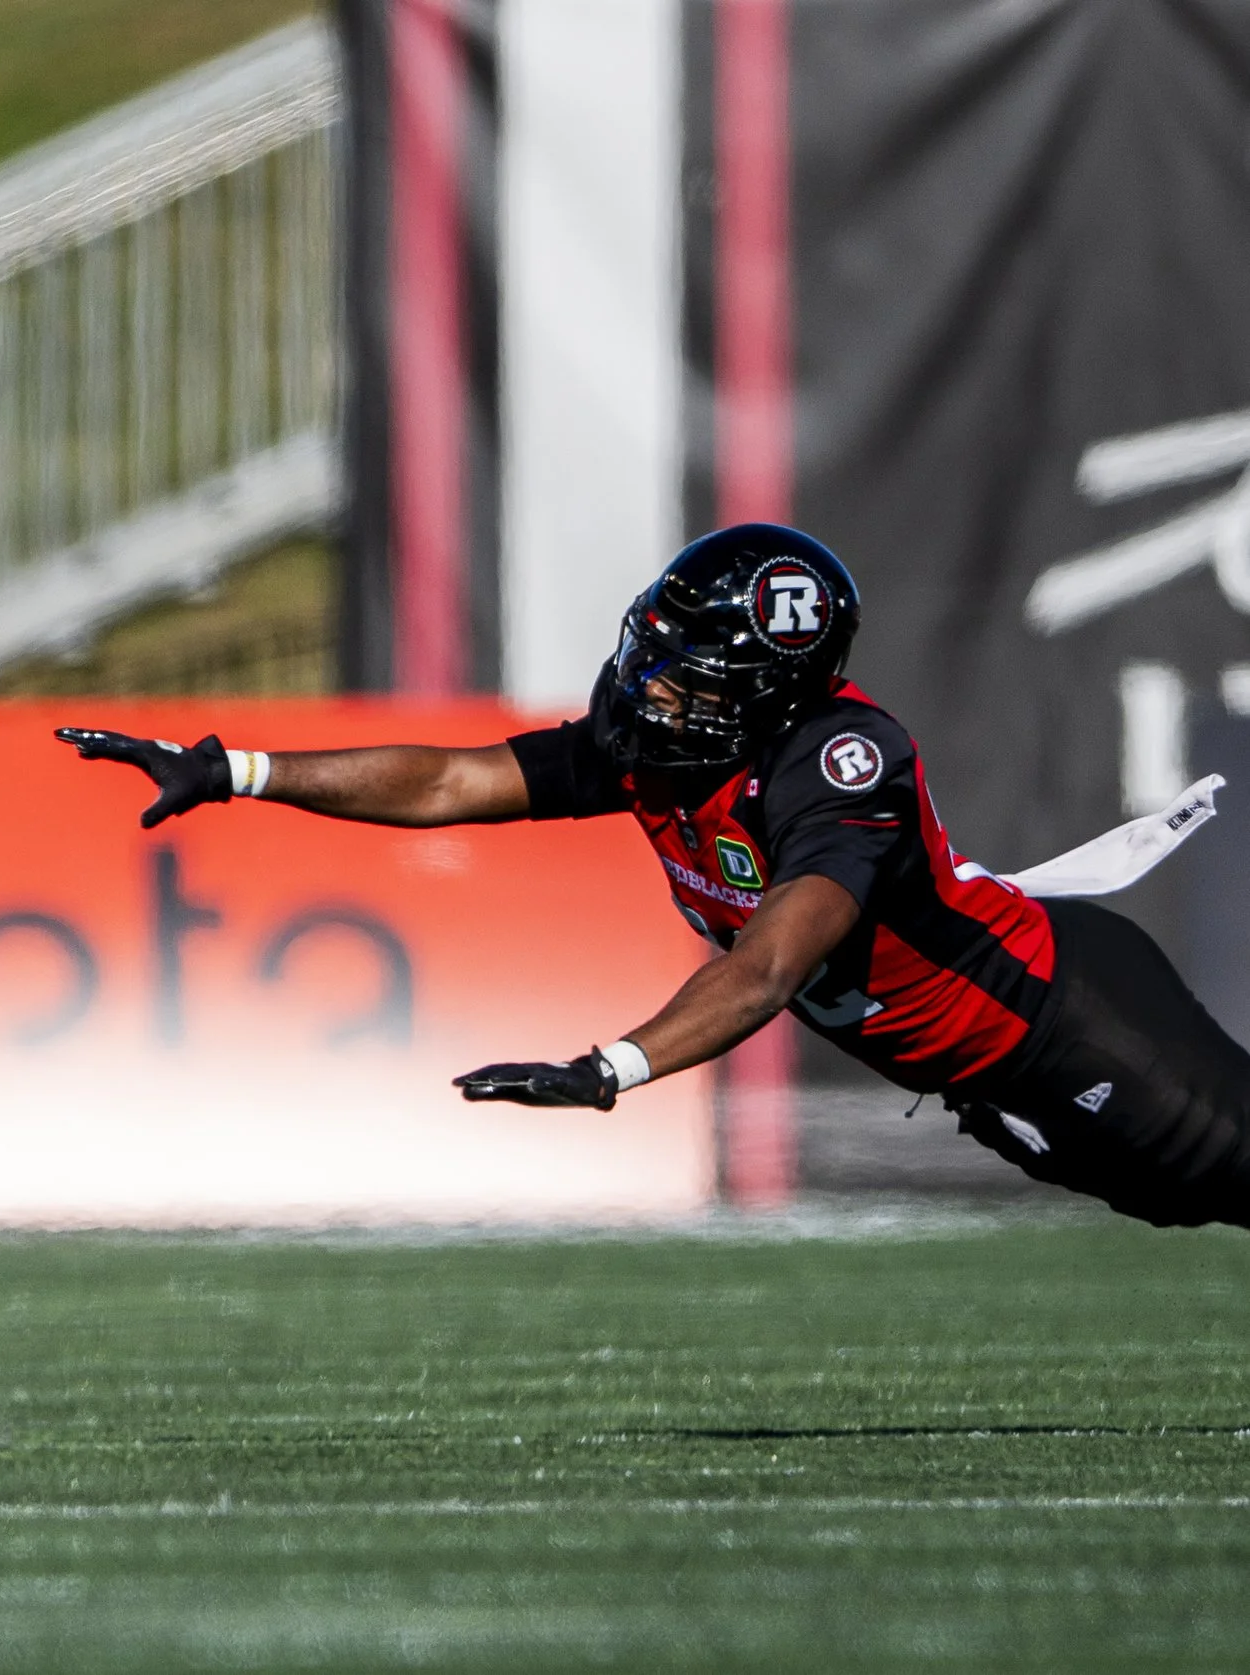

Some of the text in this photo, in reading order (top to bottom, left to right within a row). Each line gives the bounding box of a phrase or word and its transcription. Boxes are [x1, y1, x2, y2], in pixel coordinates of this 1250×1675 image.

[768, 575, 821, 633] R
[832, 740, 874, 783] R
[720, 848, 751, 877] TD
